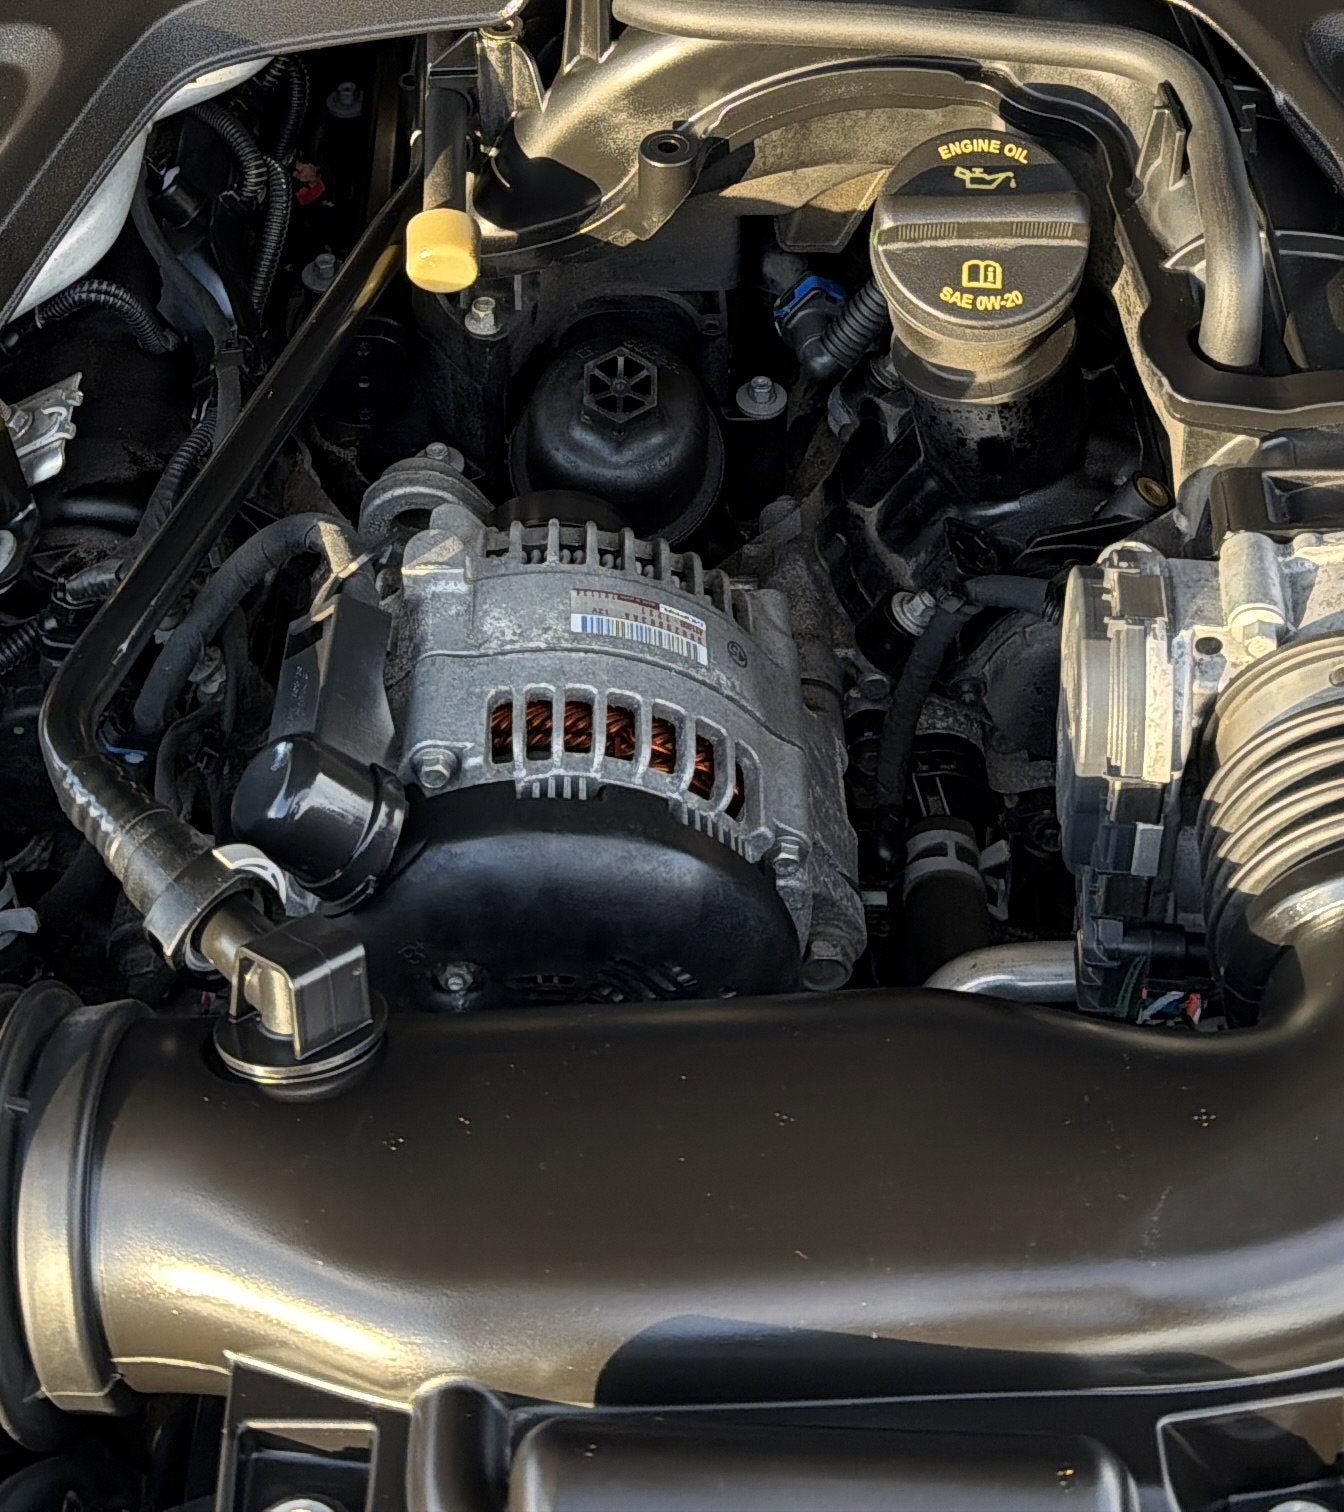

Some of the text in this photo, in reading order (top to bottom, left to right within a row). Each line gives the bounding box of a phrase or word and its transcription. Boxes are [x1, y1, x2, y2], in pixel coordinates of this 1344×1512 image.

[938, 138, 1029, 165] ENGINE OIL
[939, 285, 1024, 311] SAE 0W-20
